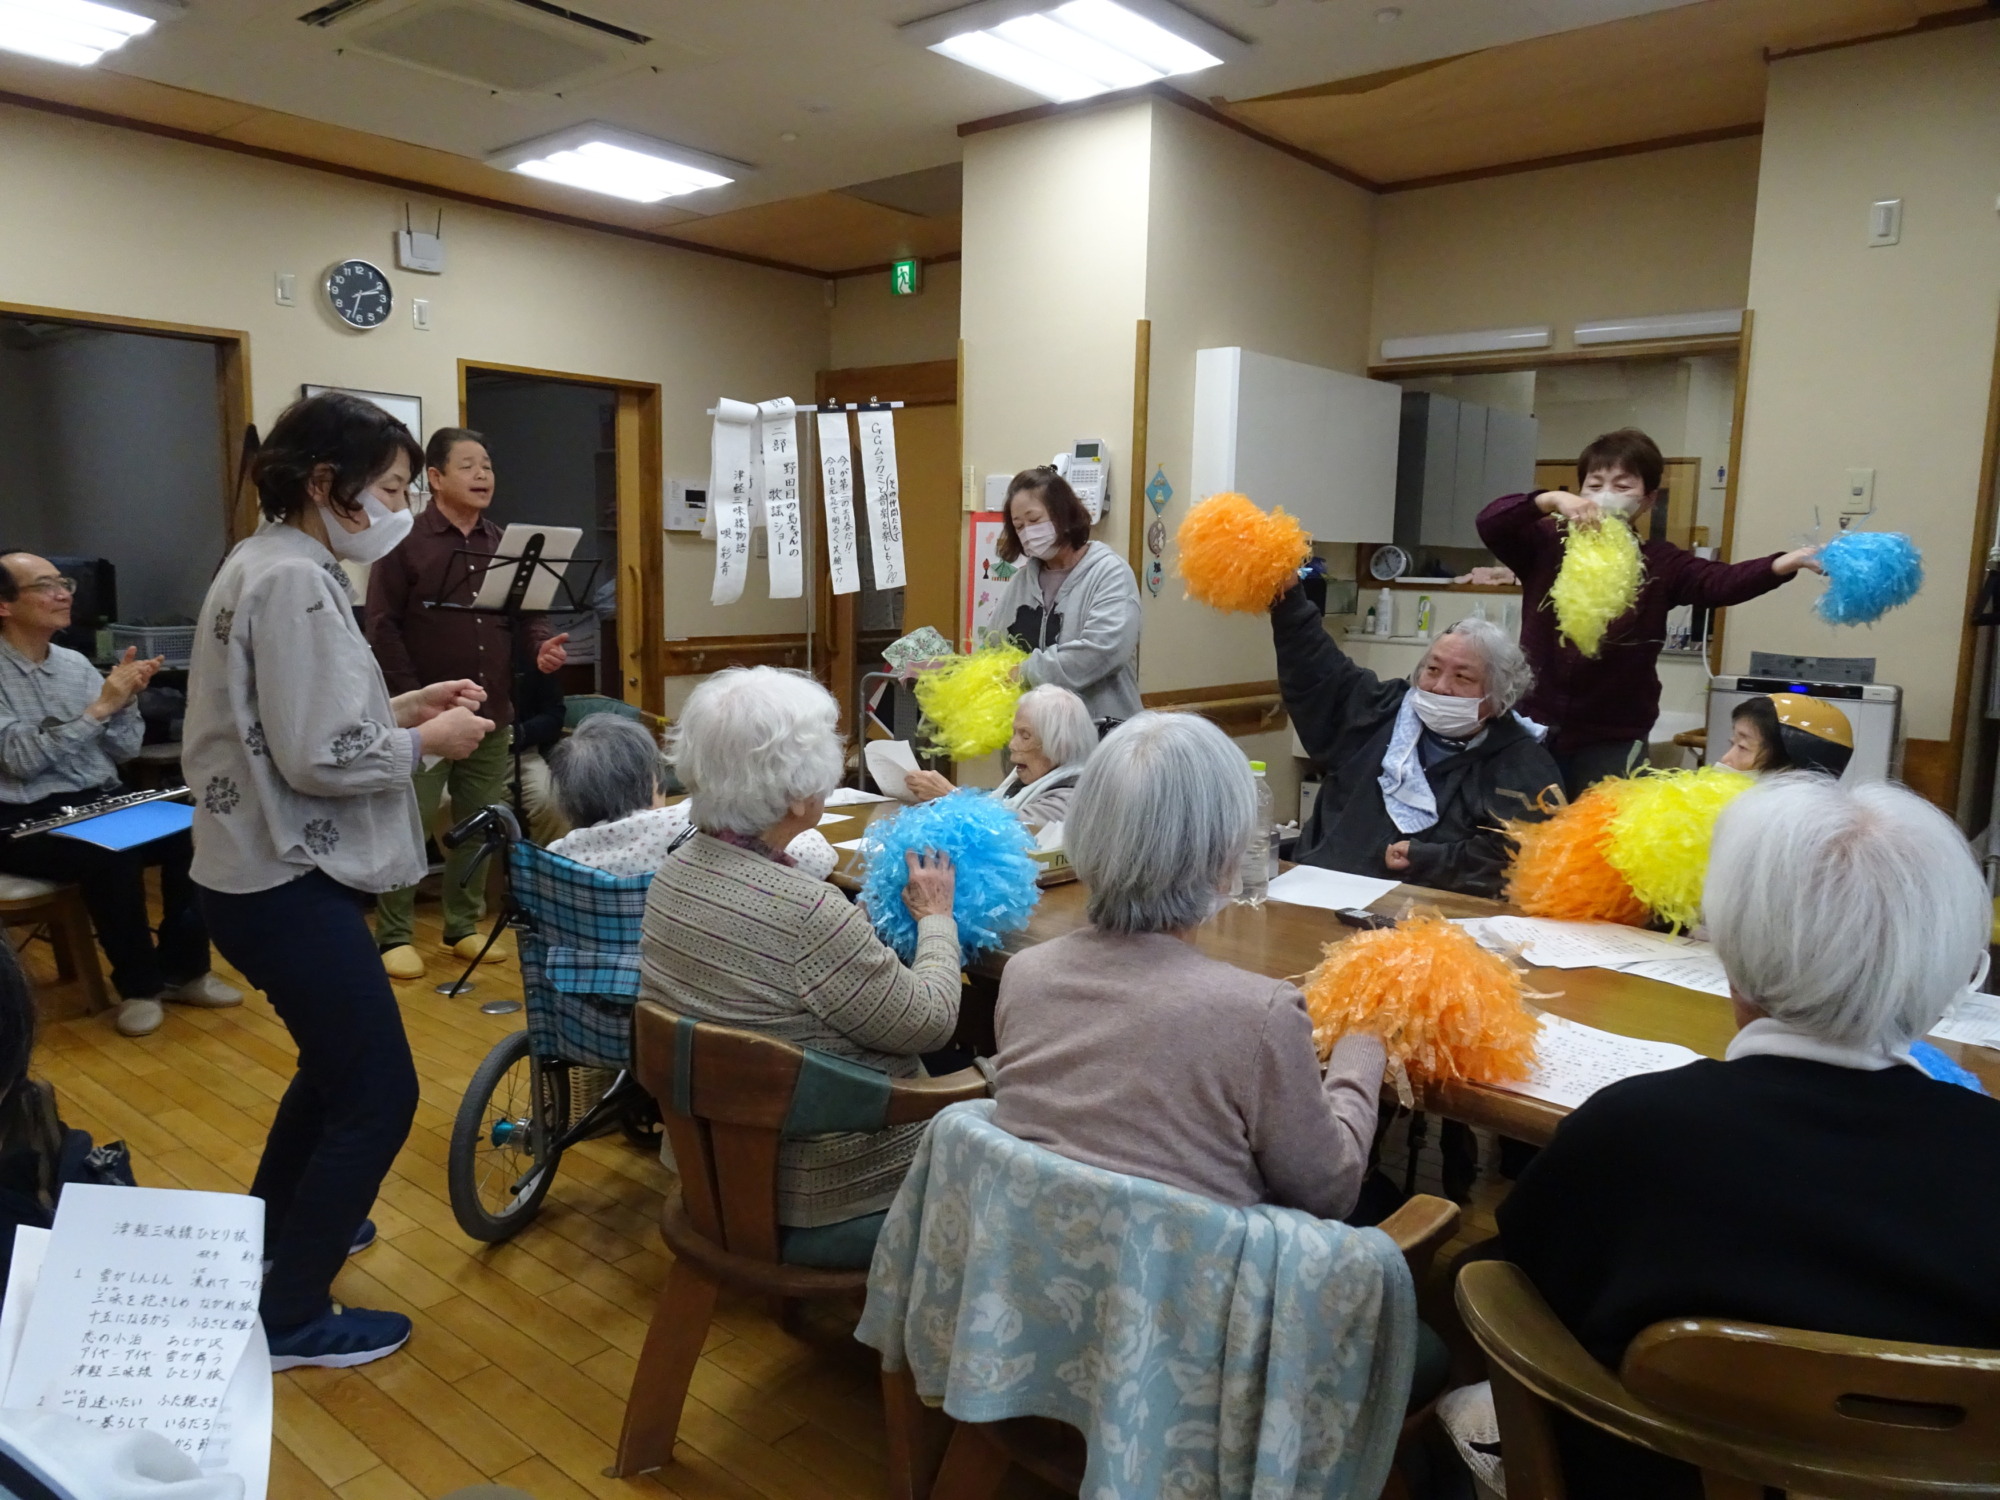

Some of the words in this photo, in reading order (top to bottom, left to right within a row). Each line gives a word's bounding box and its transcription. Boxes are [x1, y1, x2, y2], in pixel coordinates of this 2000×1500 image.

[344, 268, 351, 276] 11
[355, 266, 364, 274] 12
[335, 276, 344, 284] 10
[331, 286, 338, 295] 9
[335, 299, 342, 307] 8
[380, 295, 386, 303] 3
[345, 310, 352, 318] 7
[356, 314, 363, 322] 6
[368, 313, 375, 321] 5
[771, 427, 787, 453] 二部
[769, 488, 785, 555] 歌謡ショー
